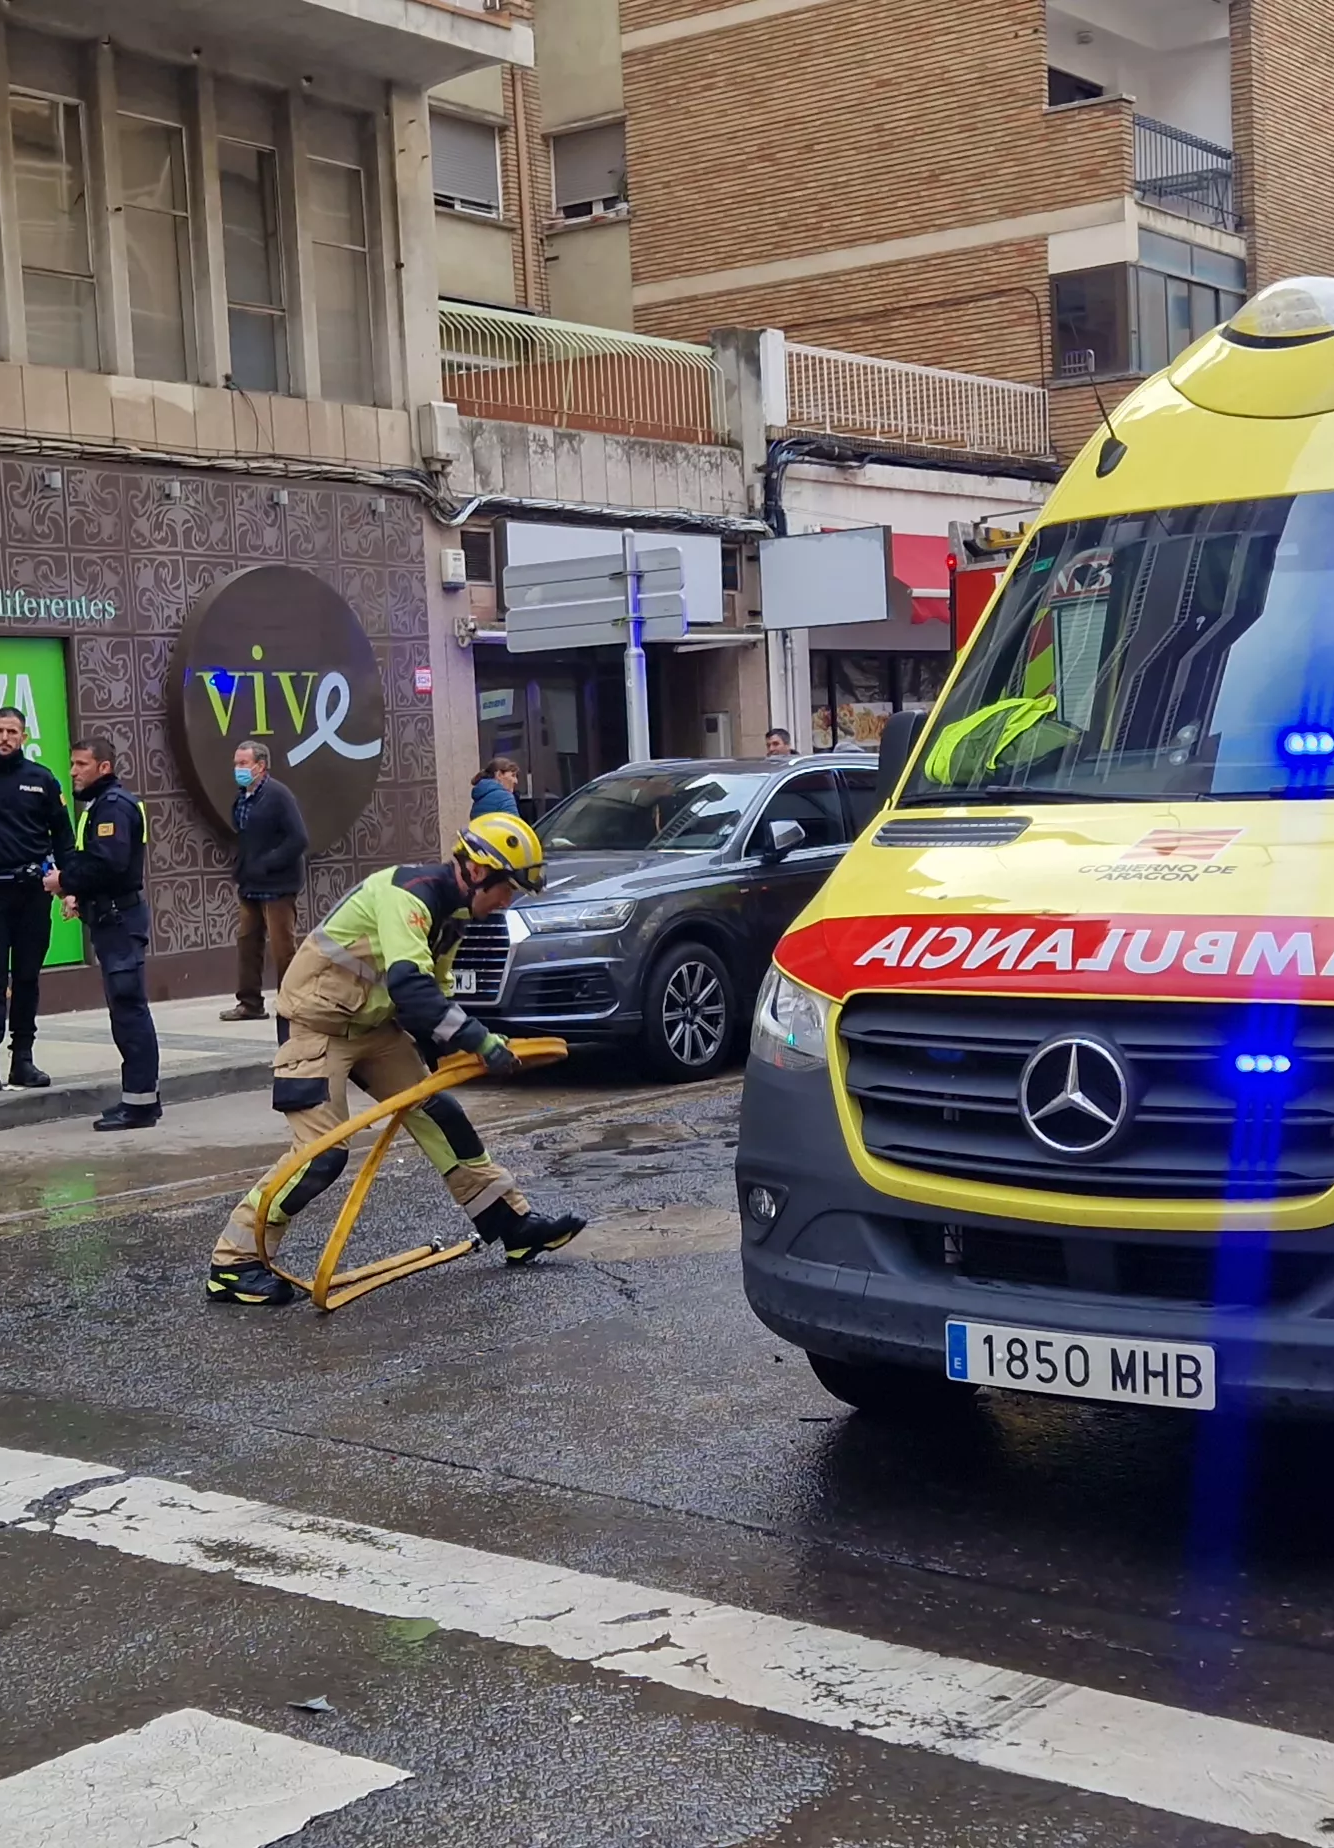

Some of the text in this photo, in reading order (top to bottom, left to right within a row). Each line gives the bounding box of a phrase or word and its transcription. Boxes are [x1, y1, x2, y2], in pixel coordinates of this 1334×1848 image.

[196, 644, 383, 768] vive
[1078, 864, 1238, 875] GOBIERNO DE
[982, 1334, 1203, 1400] 1850 MHB
